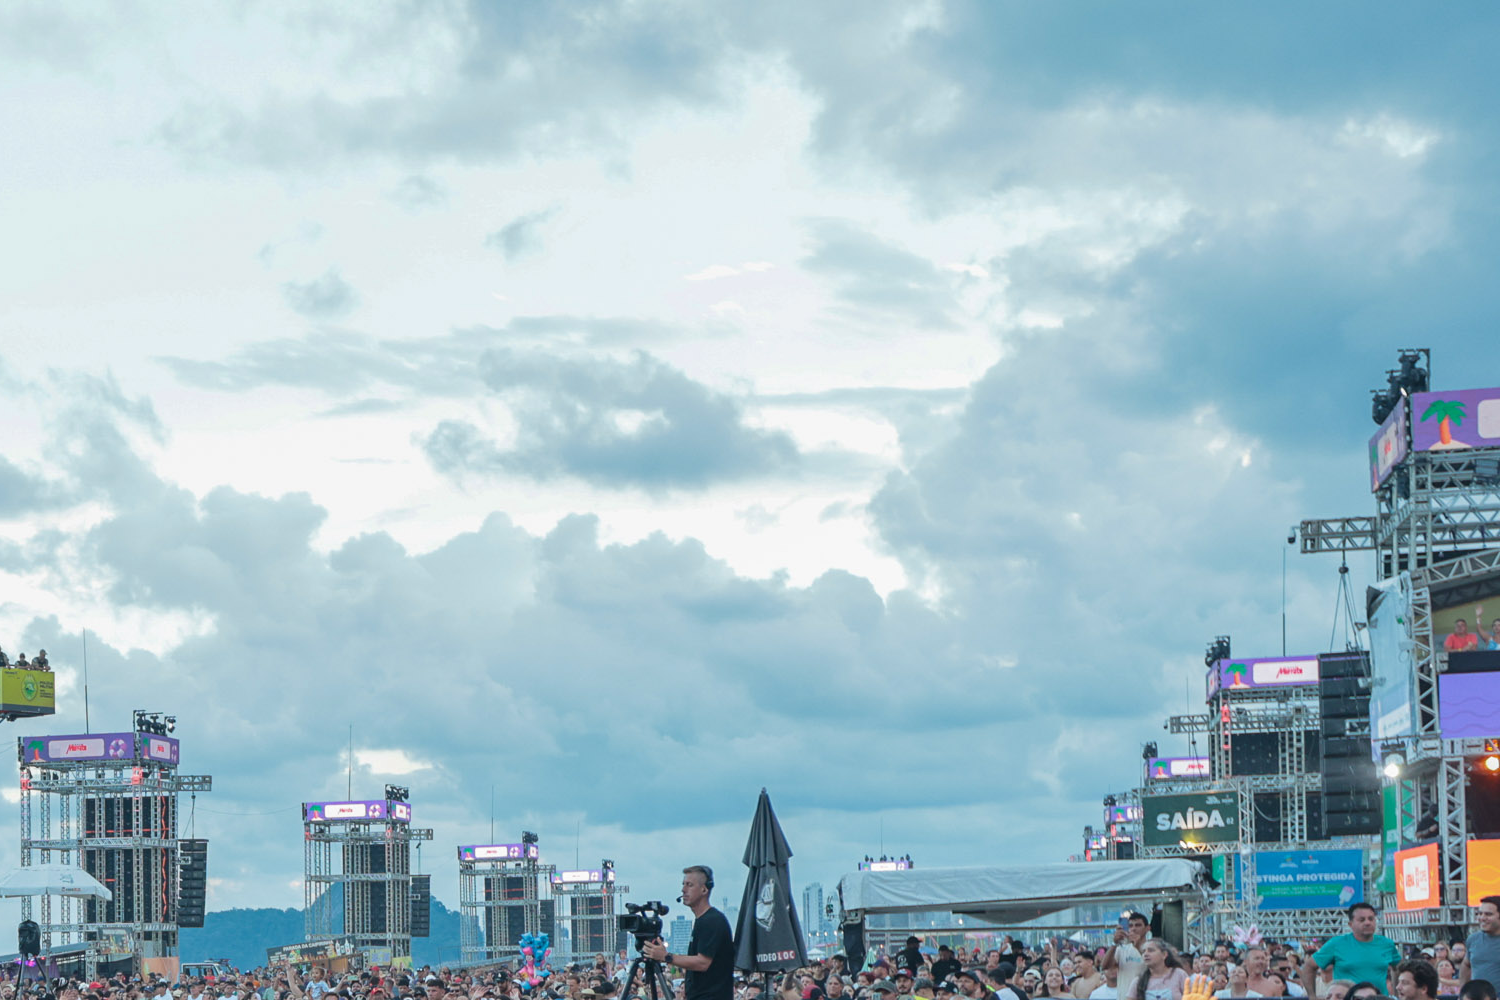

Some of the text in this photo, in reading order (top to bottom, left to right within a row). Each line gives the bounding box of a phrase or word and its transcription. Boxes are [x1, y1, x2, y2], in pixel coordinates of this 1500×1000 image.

[1156, 807, 1225, 831] SAÍDA
[1249, 872, 1356, 883] STINGA PROTEGIDA
